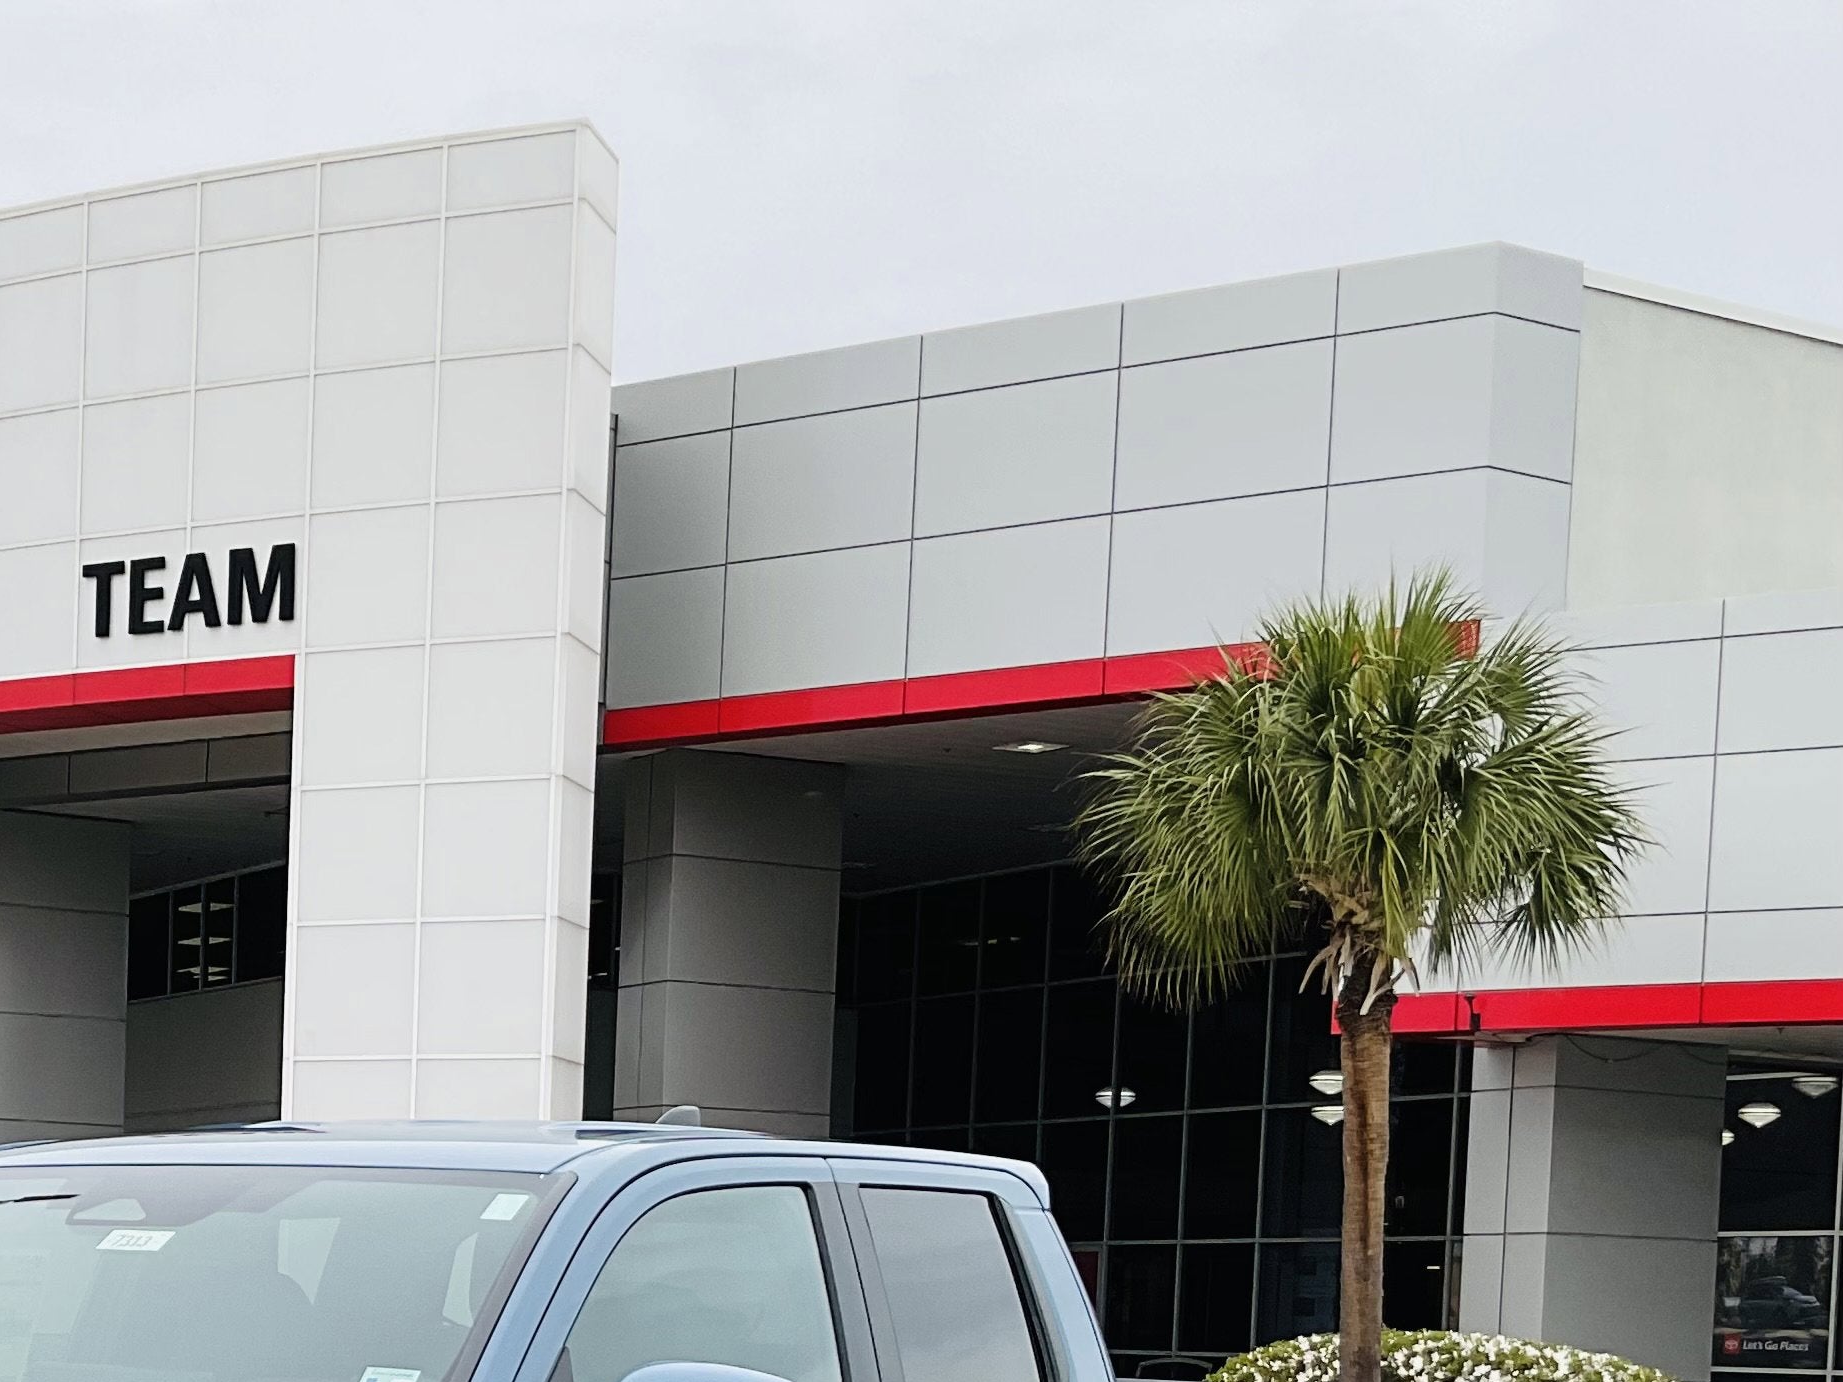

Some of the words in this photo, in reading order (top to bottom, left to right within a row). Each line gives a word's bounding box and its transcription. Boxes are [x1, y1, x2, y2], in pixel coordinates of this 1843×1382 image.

[82, 542, 296, 638] TEAM
[1764, 1341, 1778, 1351] Go
[1780, 1341, 1809, 1352] Places
